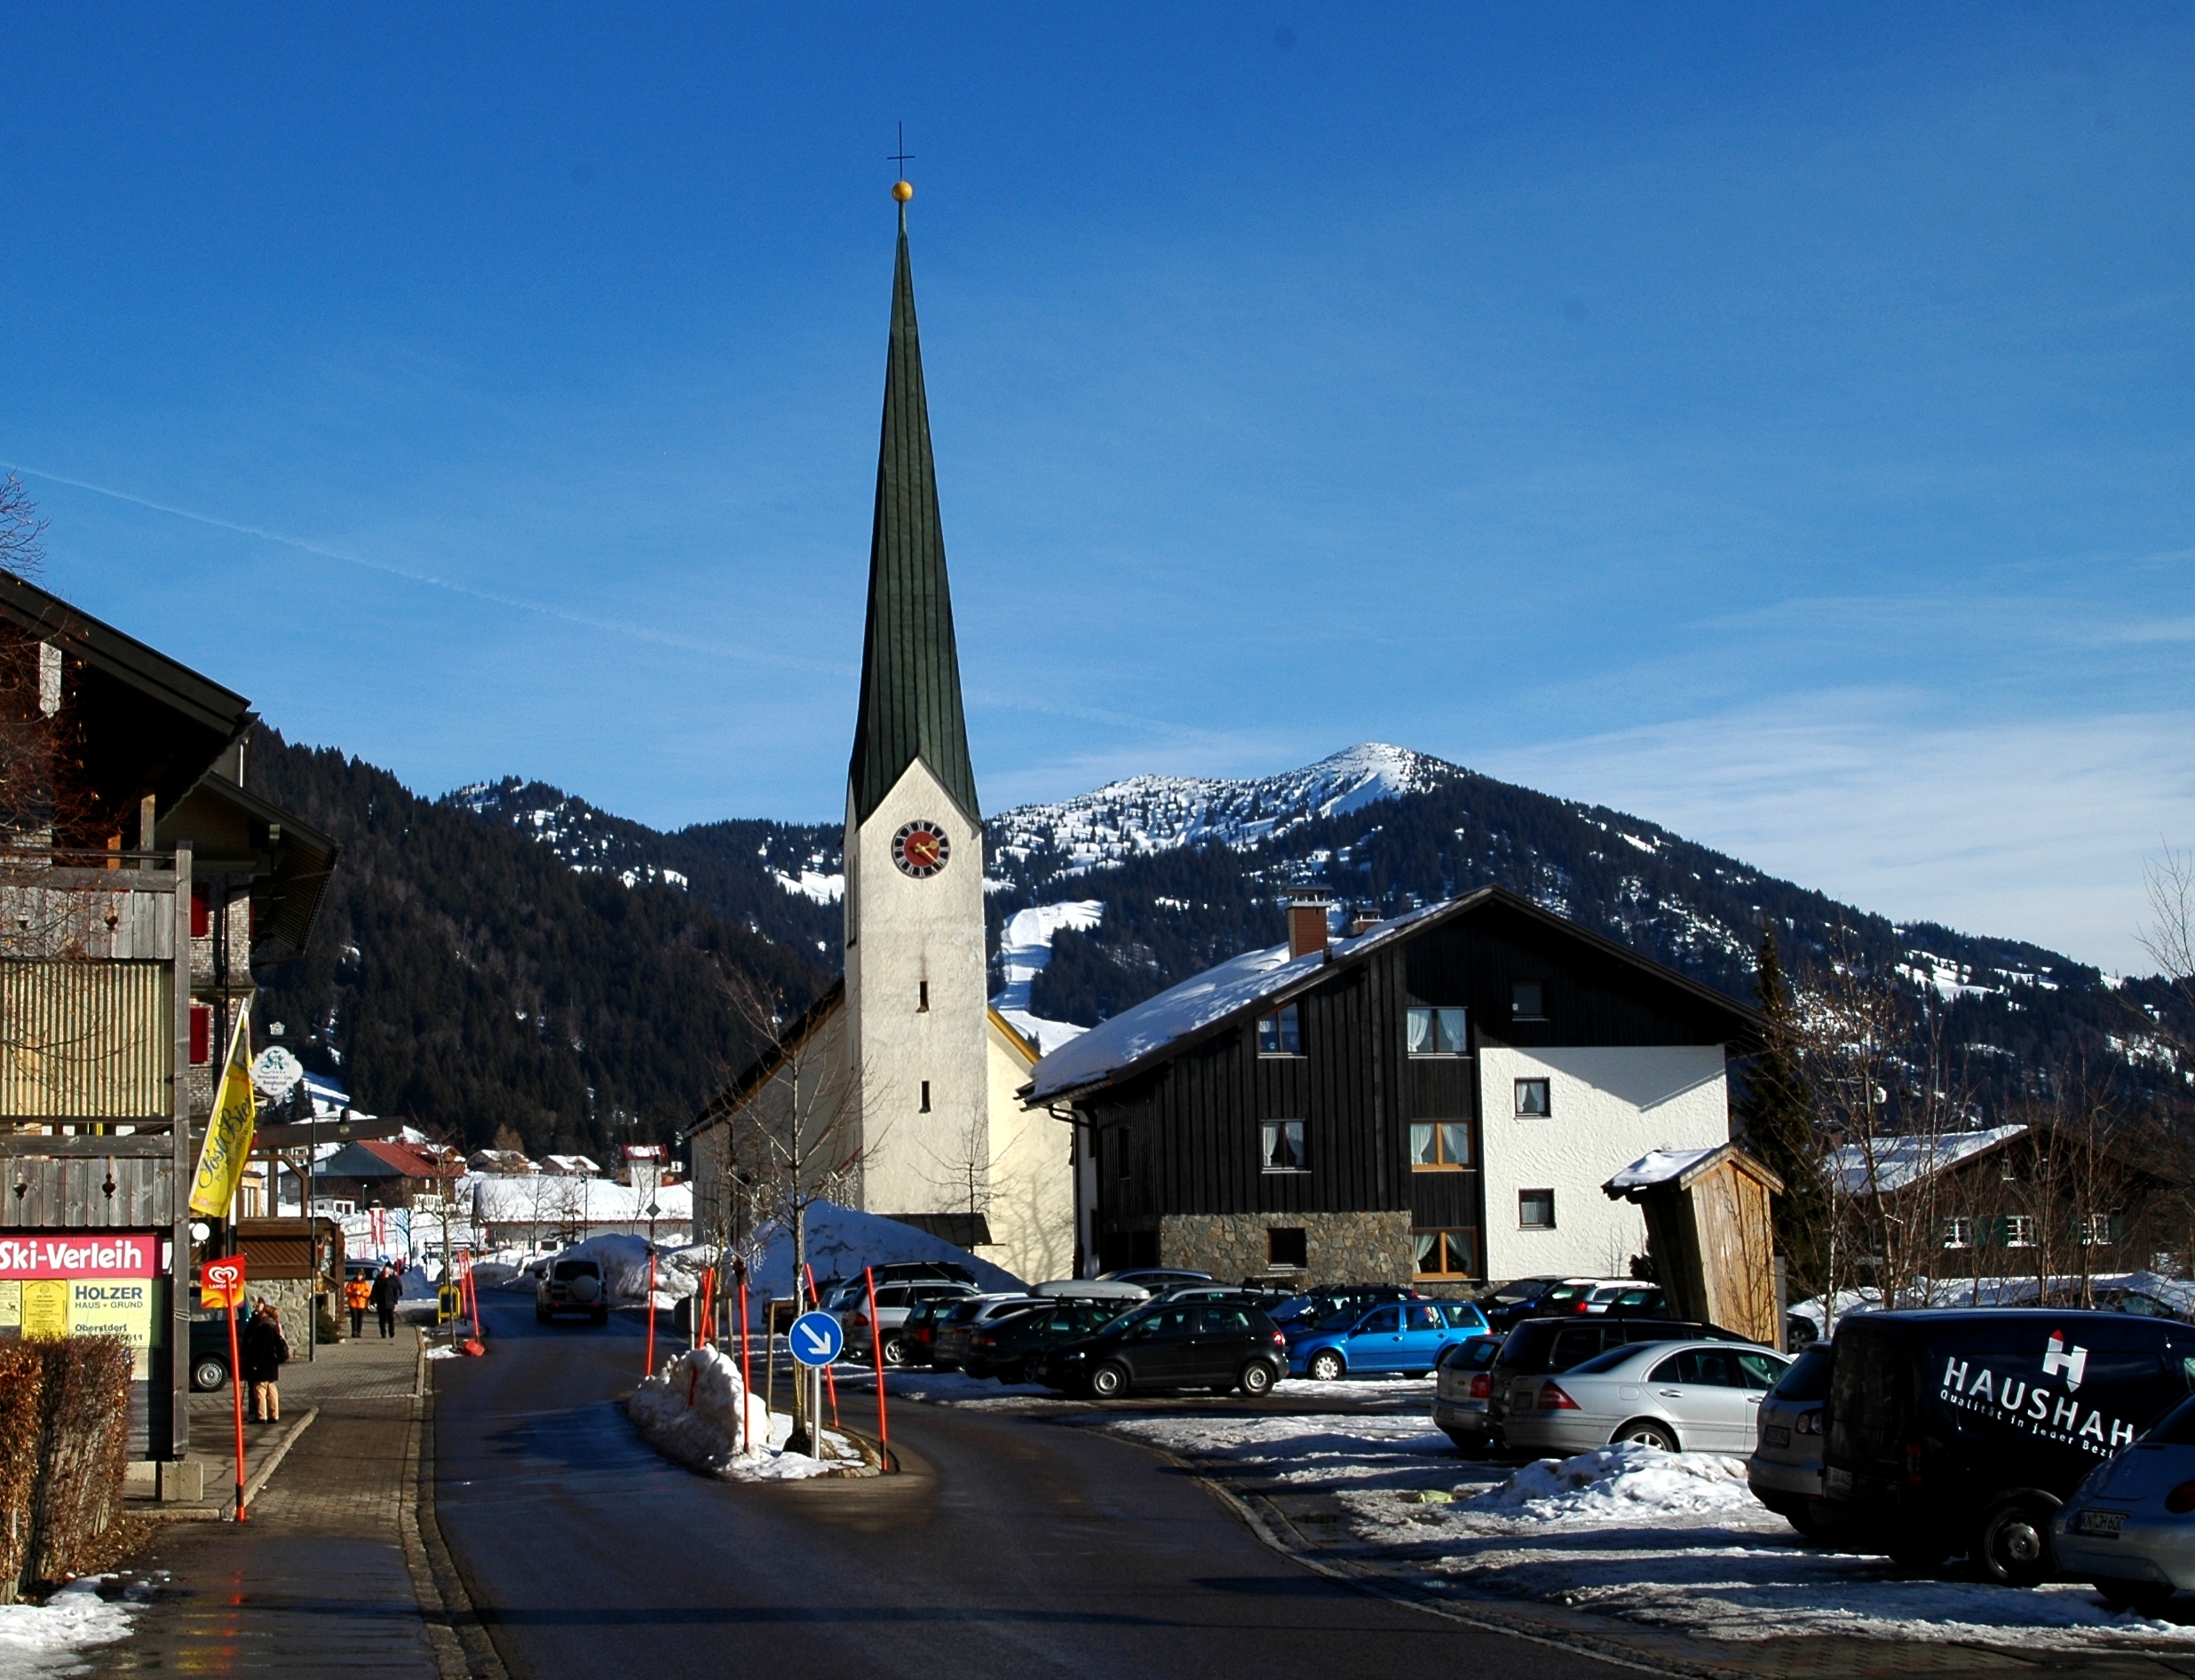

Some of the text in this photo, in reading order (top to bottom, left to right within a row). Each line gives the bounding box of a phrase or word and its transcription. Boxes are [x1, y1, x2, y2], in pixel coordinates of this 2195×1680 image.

[0, 1240, 142, 1270] Ski-Verleih
[75, 1285, 143, 1300] HOLZER
[75, 1323, 128, 1332] Oberstdorf
[1943, 1356, 2134, 1446] HAUSHAH
[1940, 1390, 2002, 1420] Qualität
[2010, 1415, 2025, 1428] in
[2032, 1422, 2074, 1445] jeder
